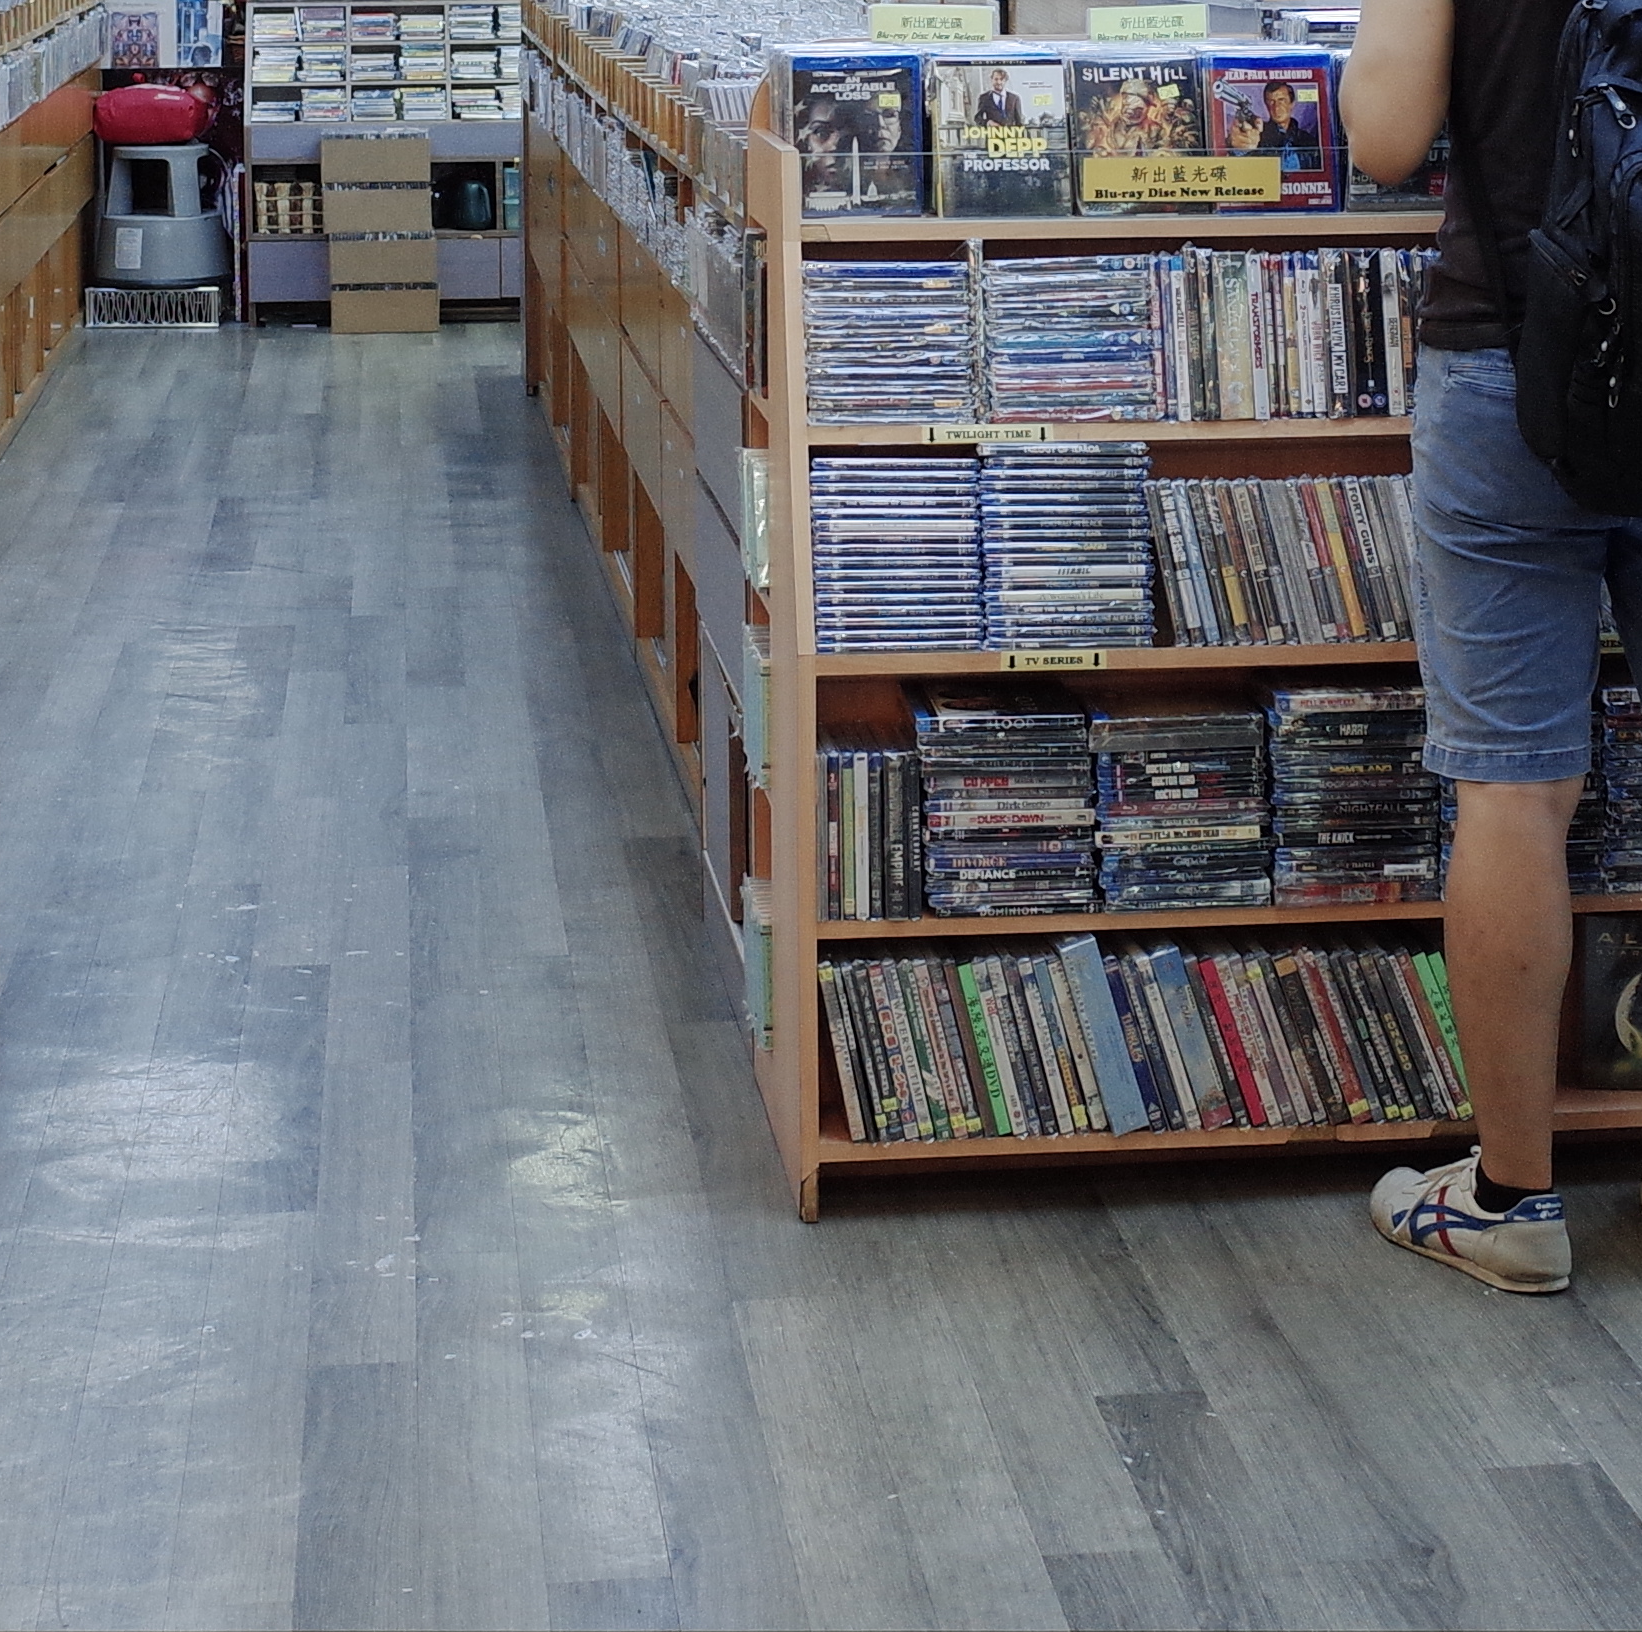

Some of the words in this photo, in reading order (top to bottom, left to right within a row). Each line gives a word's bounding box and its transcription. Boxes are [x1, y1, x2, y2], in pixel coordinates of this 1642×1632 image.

[911, 31, 929, 40] Disc
[932, 32, 950, 41] New
[953, 32, 986, 42] Release
[1153, 31, 1172, 40] New
[1174, 29, 1204, 40] Release
[844, 76, 861, 84] AN
[1082, 67, 1143, 84] SILENT
[1150, 66, 1188, 86] HILL
[1224, 69, 1268, 81] JEAN-PAUL
[1269, 69, 1313, 81] BELMONDO
[810, 81, 895, 94] ACCEPTABLE
[835, 91, 871, 101] LOSS
[962, 126, 1026, 140] JOHNNY
[987, 138, 1048, 158] DEPP
[963, 158, 1051, 172] PROFESSOR
[1131, 164, 1228, 184] 新出藍光碟
[1094, 188, 1144, 202] Blu-ray
[1147, 188, 1178, 200] Disc
[1180, 187, 1211, 199] New
[1214, 186, 1265, 198] Release
[1281, 181, 1332, 195] SIONNEL
[1249, 292, 1265, 369] TRANSFORMERS
[1333, 372, 1348, 393] CAR!
[945, 429, 1001, 440] TWILIGHT
[1004, 429, 1032, 439] TIME
[1349, 486, 1367, 526] FORTY
[1360, 528, 1376, 564] GUNS
[1025, 656, 1039, 667] TV
[1042, 655, 1084, 666] SERIES
[1339, 724, 1369, 736] HARRY
[1329, 764, 1393, 774] HOMELAND
[963, 777, 1009, 788] COPPER
[1151, 776, 1178, 787] DOCTOR
[997, 801, 1020, 811] Dirk
[977, 814, 1008, 824] DUSK
[1011, 813, 1045, 824] DAWN
[1318, 832, 1331, 844] THE
[1332, 832, 1355, 844] KNICK
[890, 843, 904, 887] EMPIRE
[951, 856, 1007, 869] DIVORCE
[959, 869, 1016, 880] DEFIANCE
[979, 905, 1039, 917] DOMINION
[1382, 1012, 1412, 1071] RONALDO
[893, 1000, 912, 1052] WATERS
[910, 1072, 925, 1105] TIME
